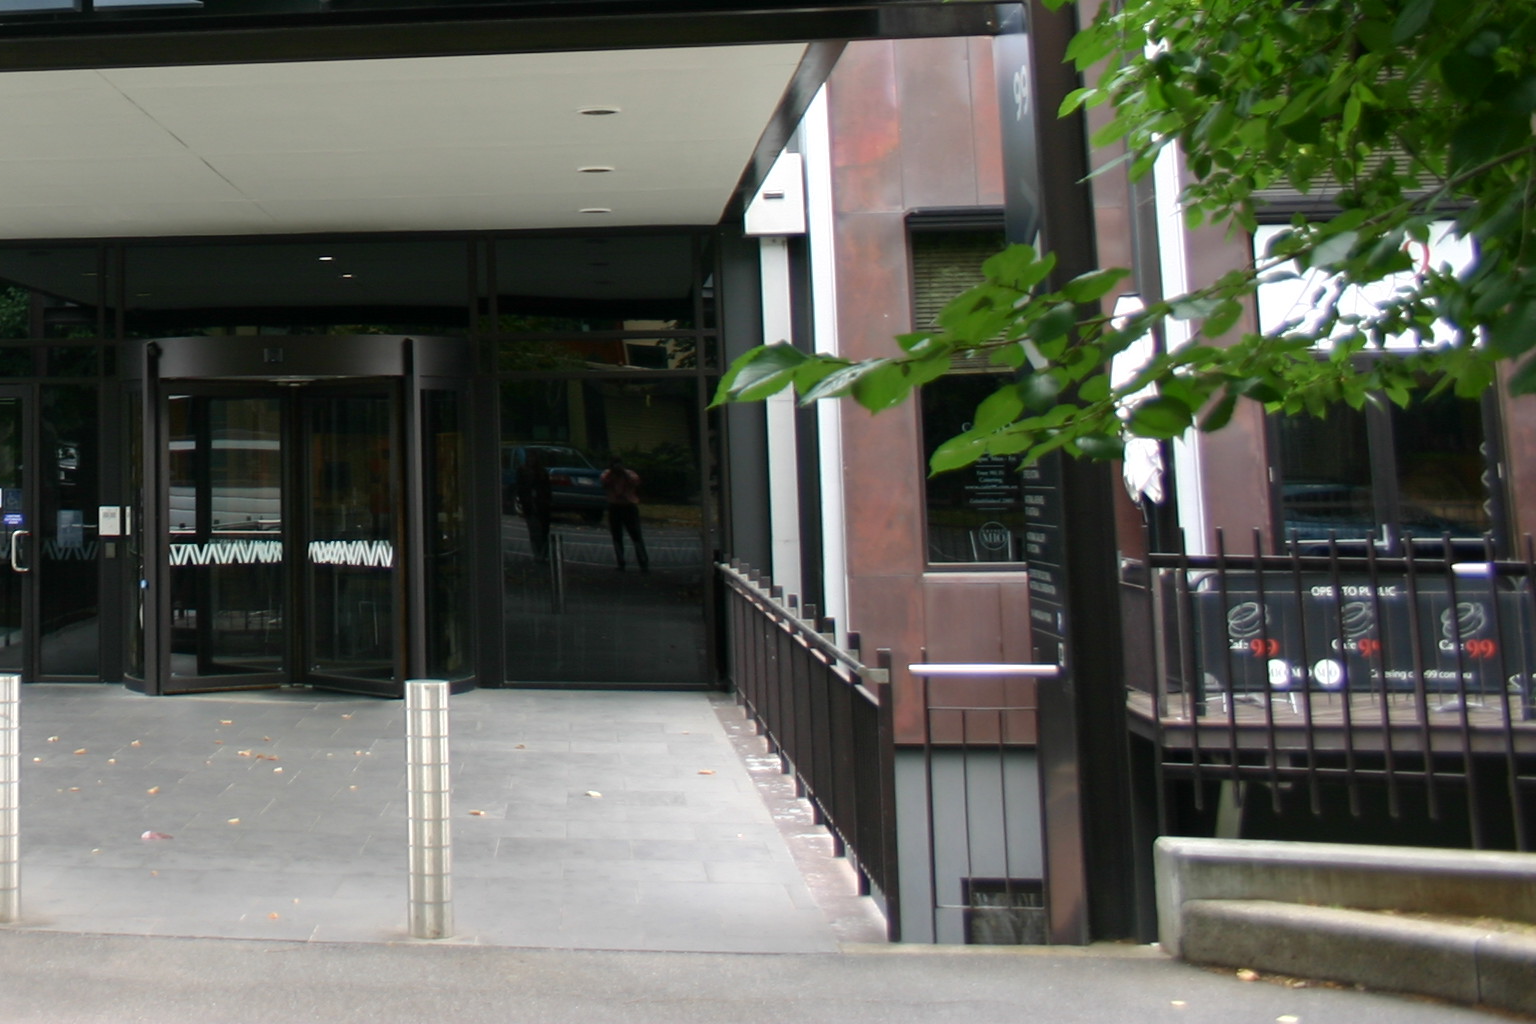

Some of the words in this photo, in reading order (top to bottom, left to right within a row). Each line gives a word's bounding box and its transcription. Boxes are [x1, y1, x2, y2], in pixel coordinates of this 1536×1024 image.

[1013, 64, 1028, 122] 99
[1310, 585, 1341, 597] OPE
[1358, 585, 1397, 597] PULIC
[1466, 637, 1498, 659] 99
